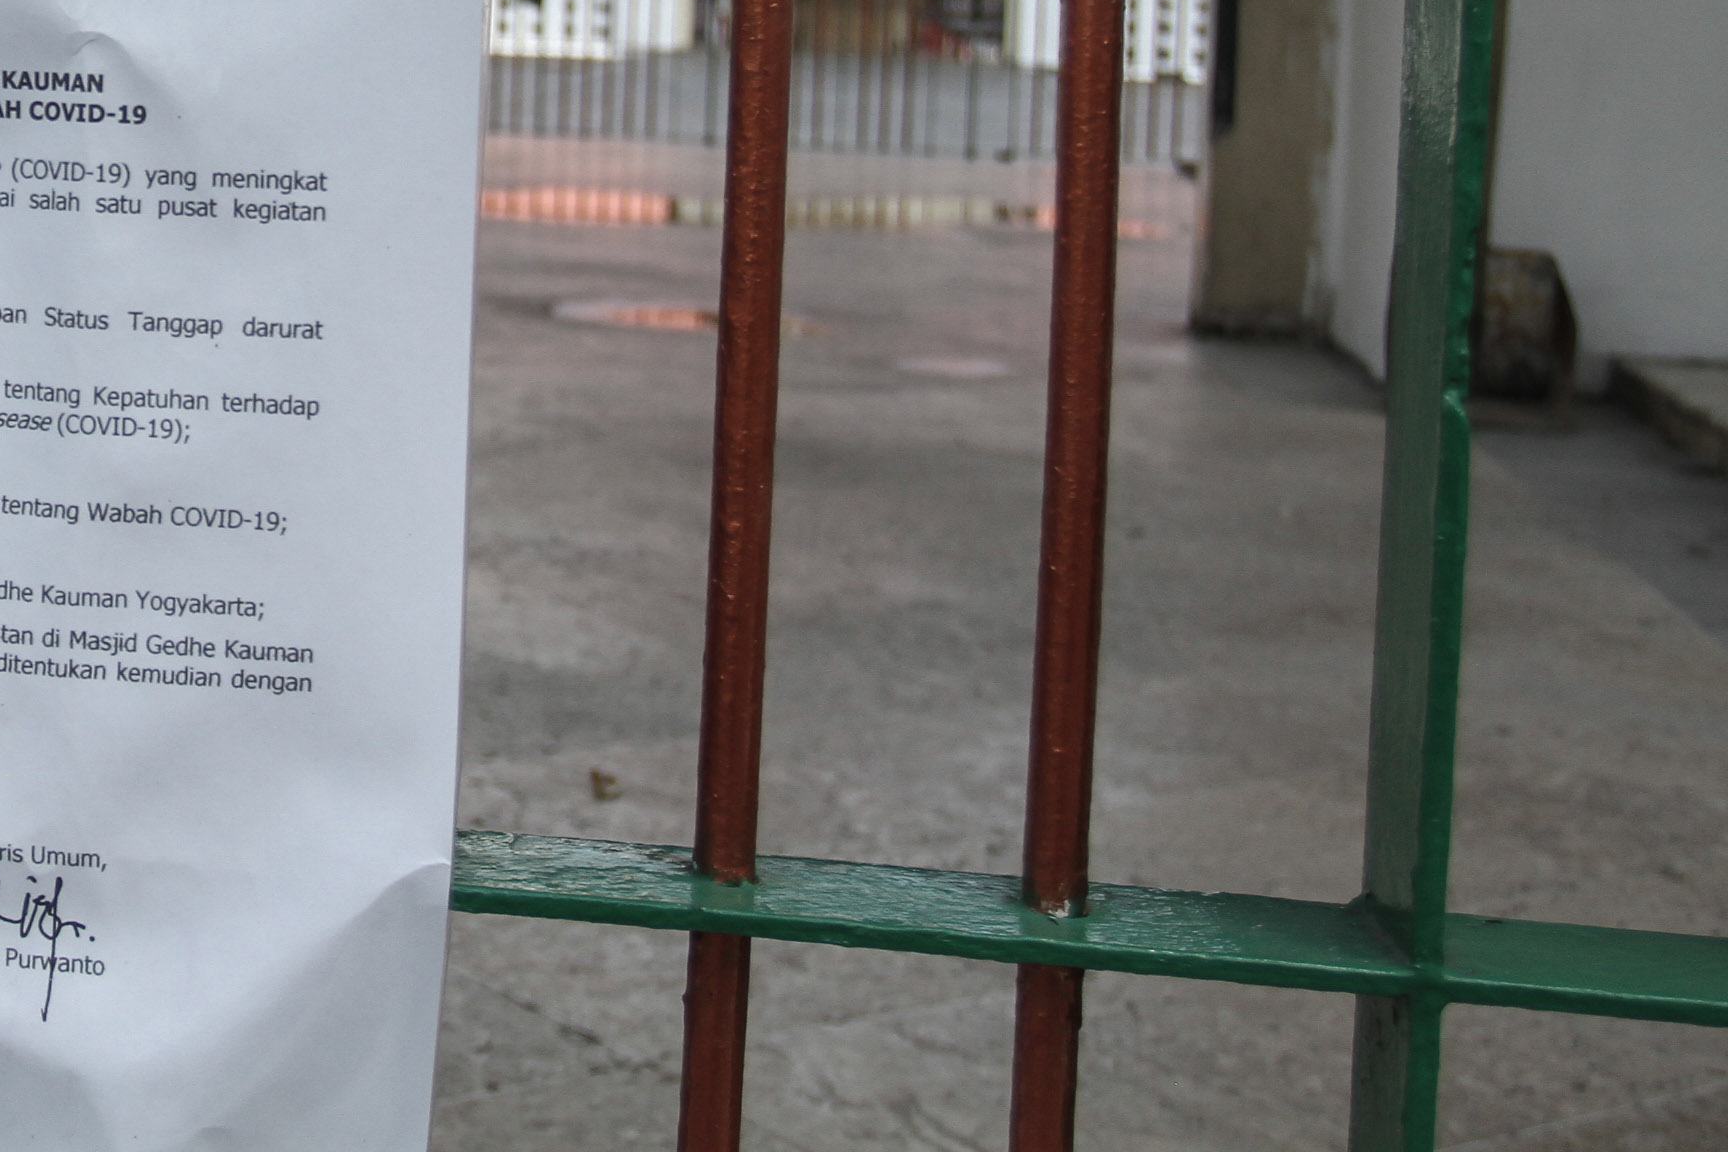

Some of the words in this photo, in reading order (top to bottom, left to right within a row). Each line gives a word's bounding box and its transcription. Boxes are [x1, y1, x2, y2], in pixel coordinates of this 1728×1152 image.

[2, 70, 104, 94] KAUMAN
[28, 100, 147, 125] COVID-19
[12, 158, 130, 188] (COVID-19)
[144, 170, 198, 192] yang
[212, 170, 328, 195] meningkat
[44, 306, 110, 330] Status
[127, 311, 224, 340] Tanggap
[242, 316, 324, 340] darurat
[42, 628, 60, 648] di
[69, 630, 138, 656] Masjid
[146, 634, 216, 658] Gedhe
[224, 640, 314, 664] Kauman
[31, 846, 107, 872] Umum,
[5, 947, 105, 976] Purwanto
